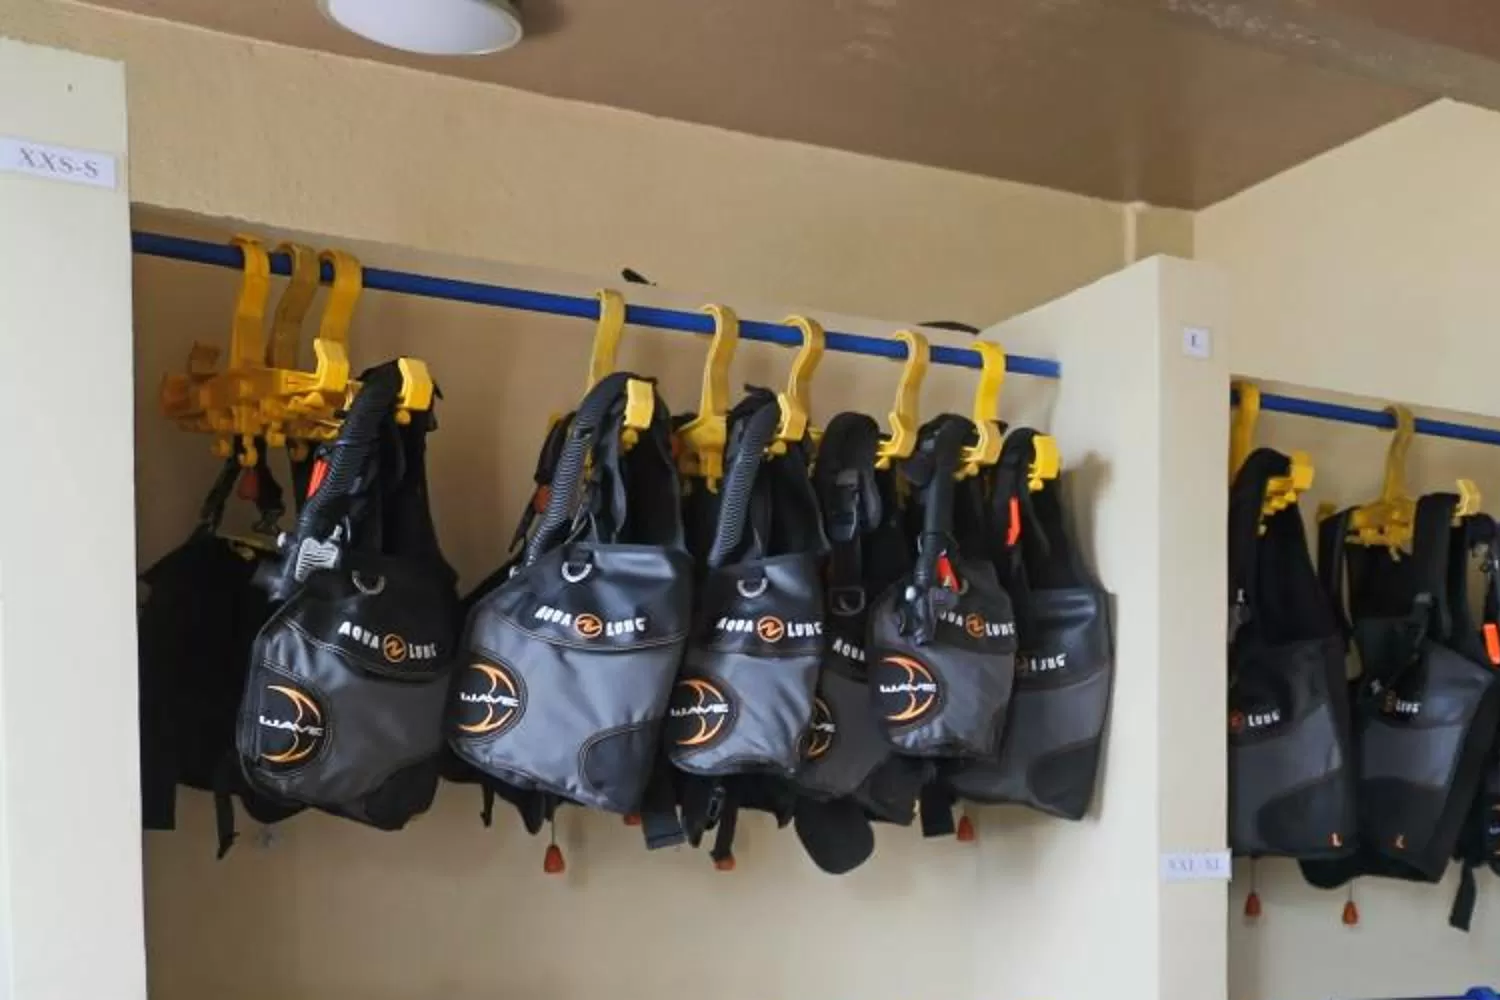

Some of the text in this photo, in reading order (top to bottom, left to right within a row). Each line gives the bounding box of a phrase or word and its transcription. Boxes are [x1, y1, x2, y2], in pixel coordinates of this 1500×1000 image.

[20, 147, 99, 178] XXS-S
[533, 606, 648, 637] AQUA LUNG
[715, 617, 823, 638] AQUA LUNG
[338, 621, 380, 650] AQUA
[832, 637, 866, 662] AQUA
[878, 683, 938, 694] WAVE
[459, 692, 519, 707] WAVE
[670, 703, 729, 717] WAVE
[259, 716, 324, 737] WAVE
[1247, 709, 1281, 728] LUNG
